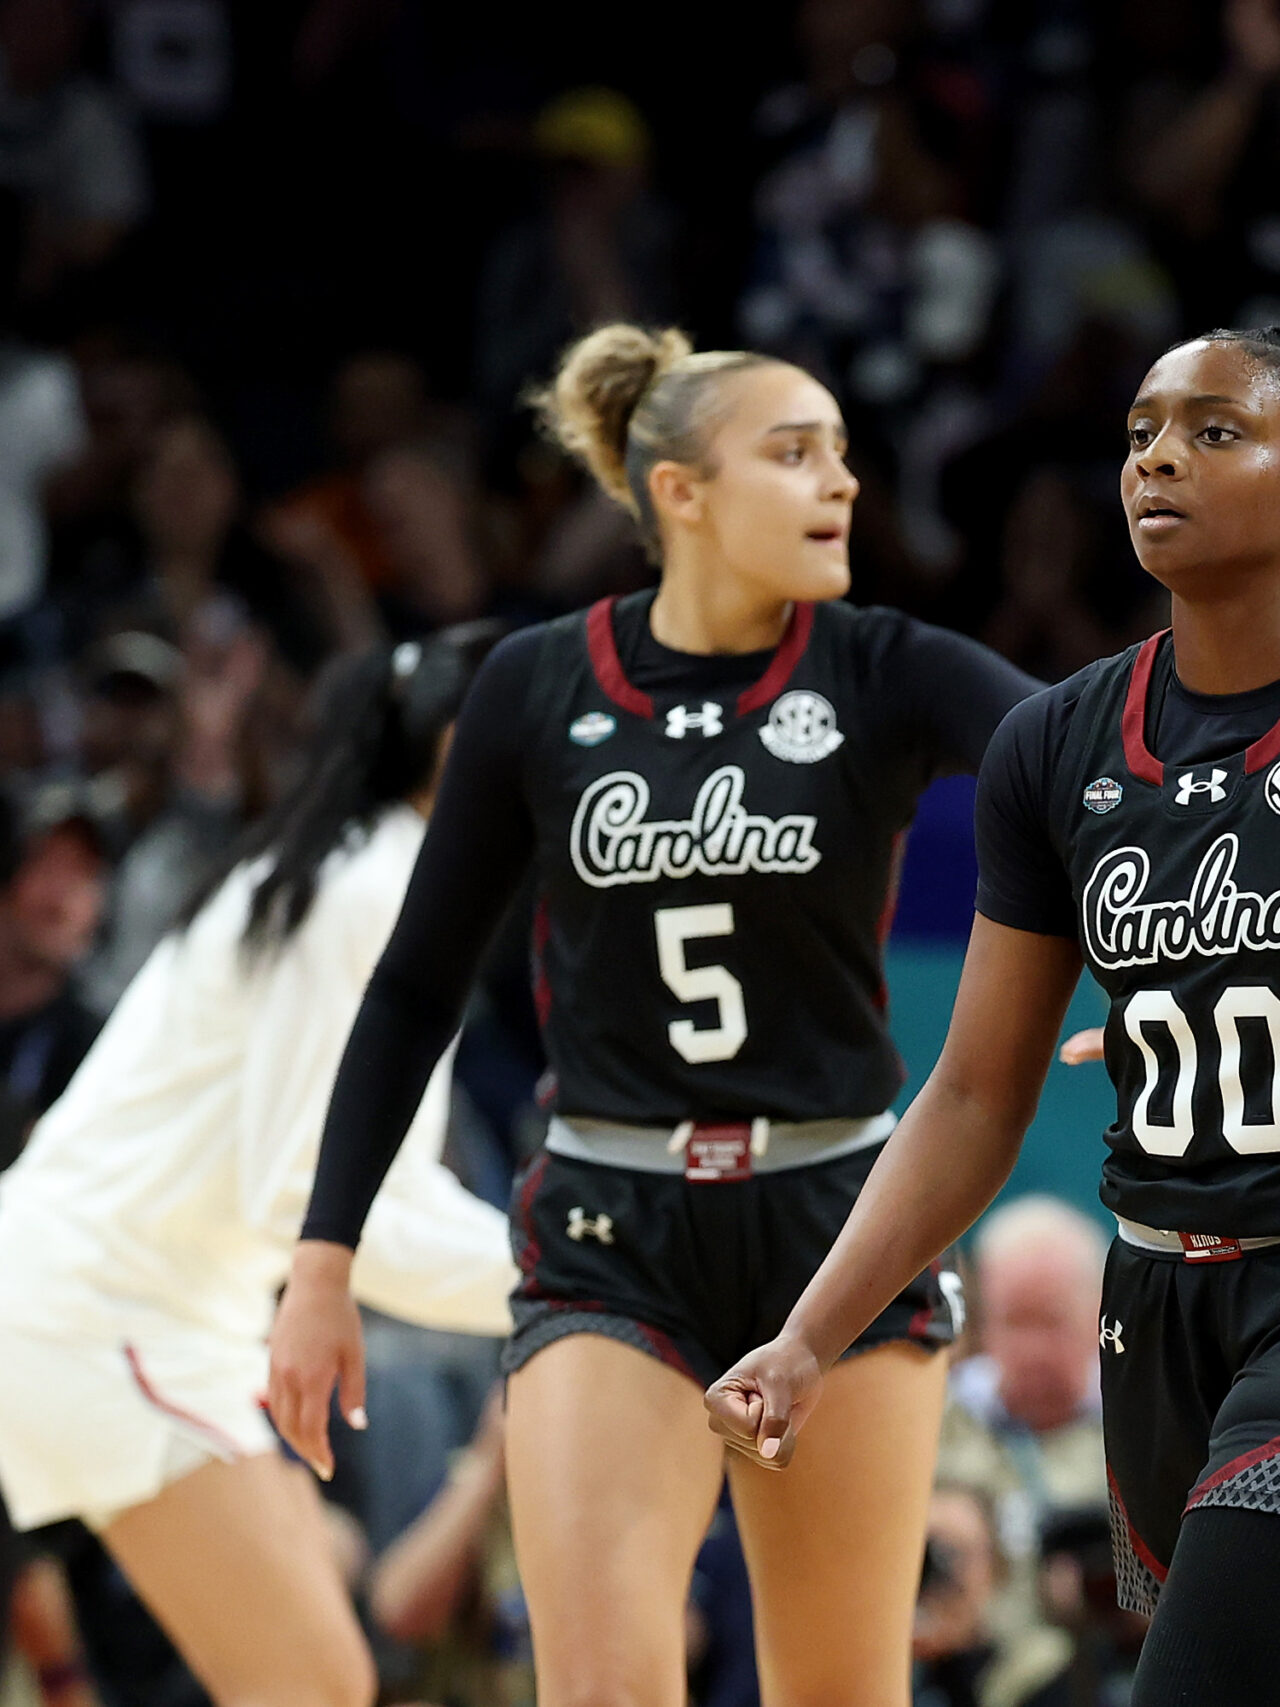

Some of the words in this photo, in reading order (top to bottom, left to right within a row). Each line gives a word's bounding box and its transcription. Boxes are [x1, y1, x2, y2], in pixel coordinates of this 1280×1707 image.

[570, 765, 822, 888] Carolina
[1085, 790, 1103, 801] FINAL
[1103, 789, 1120, 800] FOUR
[654, 903, 748, 1064] 5
